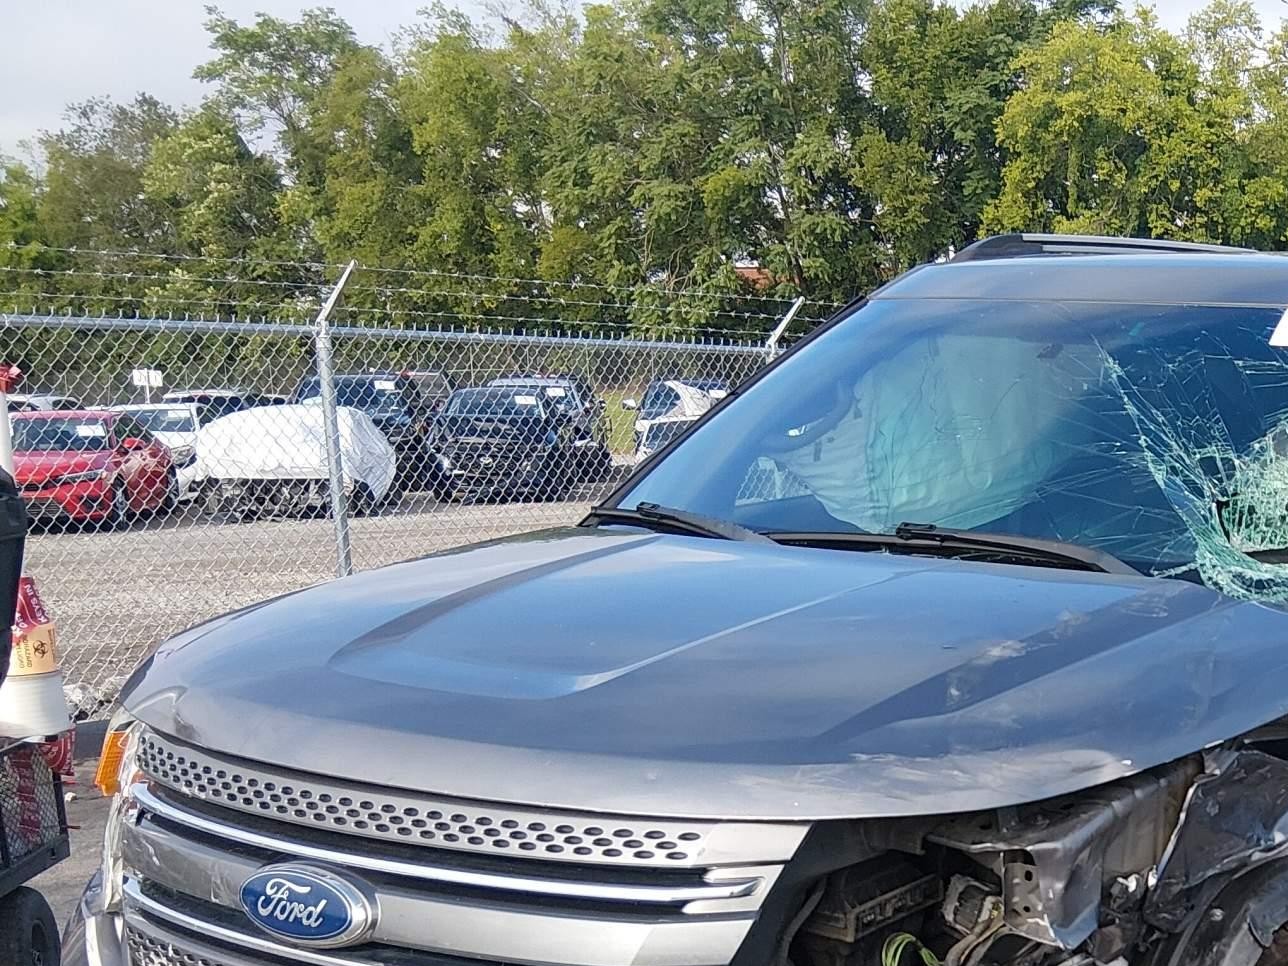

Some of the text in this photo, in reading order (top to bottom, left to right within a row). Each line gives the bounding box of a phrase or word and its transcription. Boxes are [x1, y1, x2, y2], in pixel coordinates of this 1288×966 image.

[24, 584, 34, 597] IN
[31, 598, 49, 624] KEYS
[257, 878, 328, 928] Ford
